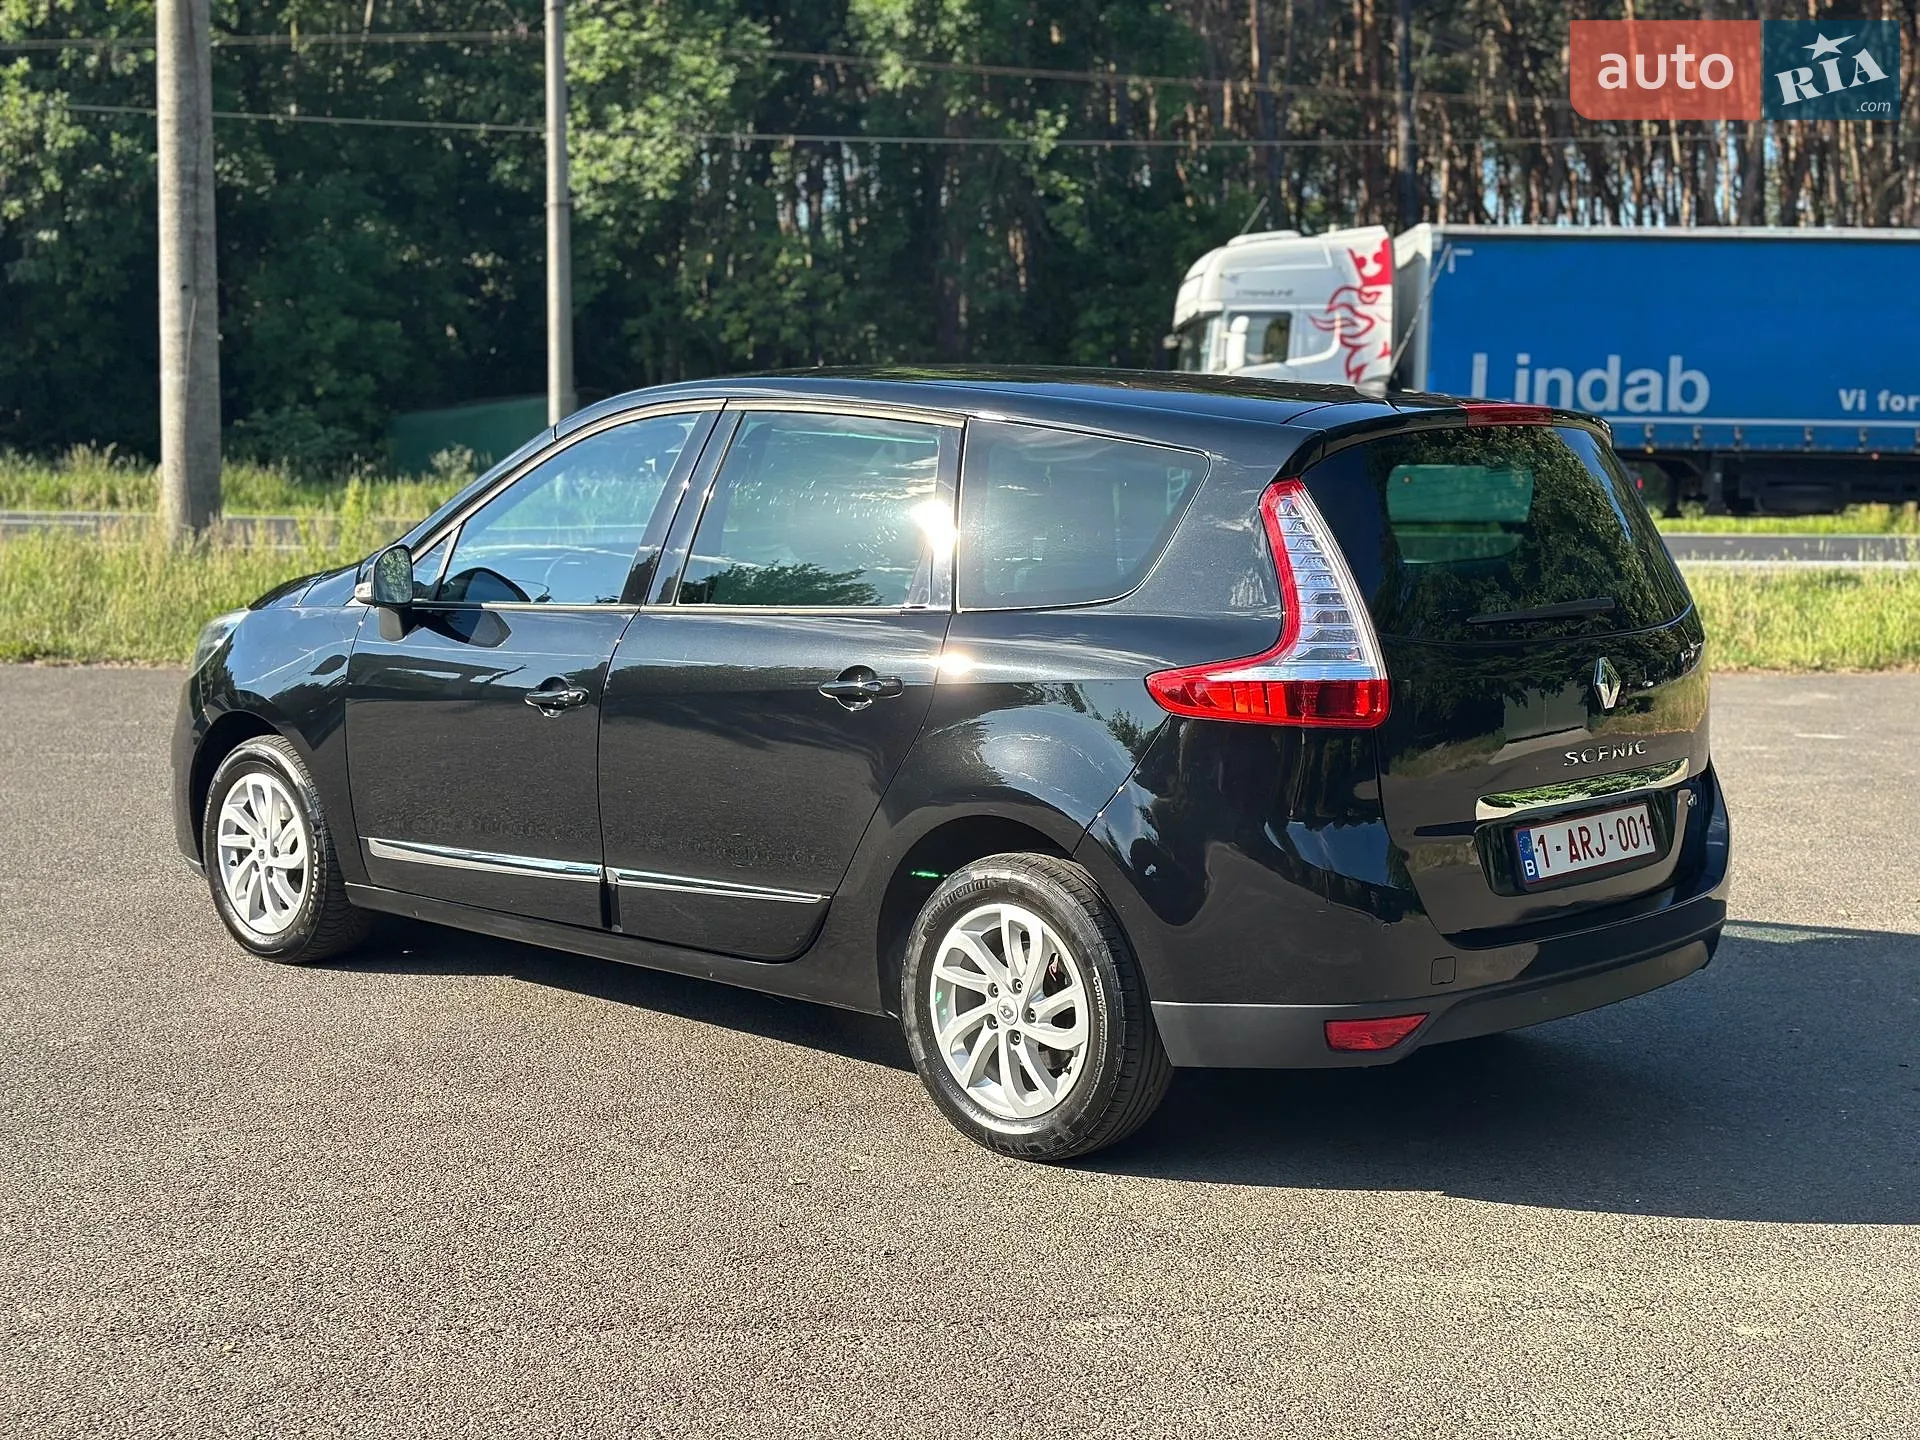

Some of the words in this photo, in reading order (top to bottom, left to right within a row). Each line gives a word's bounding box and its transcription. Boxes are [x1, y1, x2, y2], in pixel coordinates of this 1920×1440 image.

[1471, 352, 1711, 414] Lindab
[1838, 388, 1867, 412] Vi
[1563, 740, 1648, 767] SCENIC
[1525, 859, 1537, 876] B
